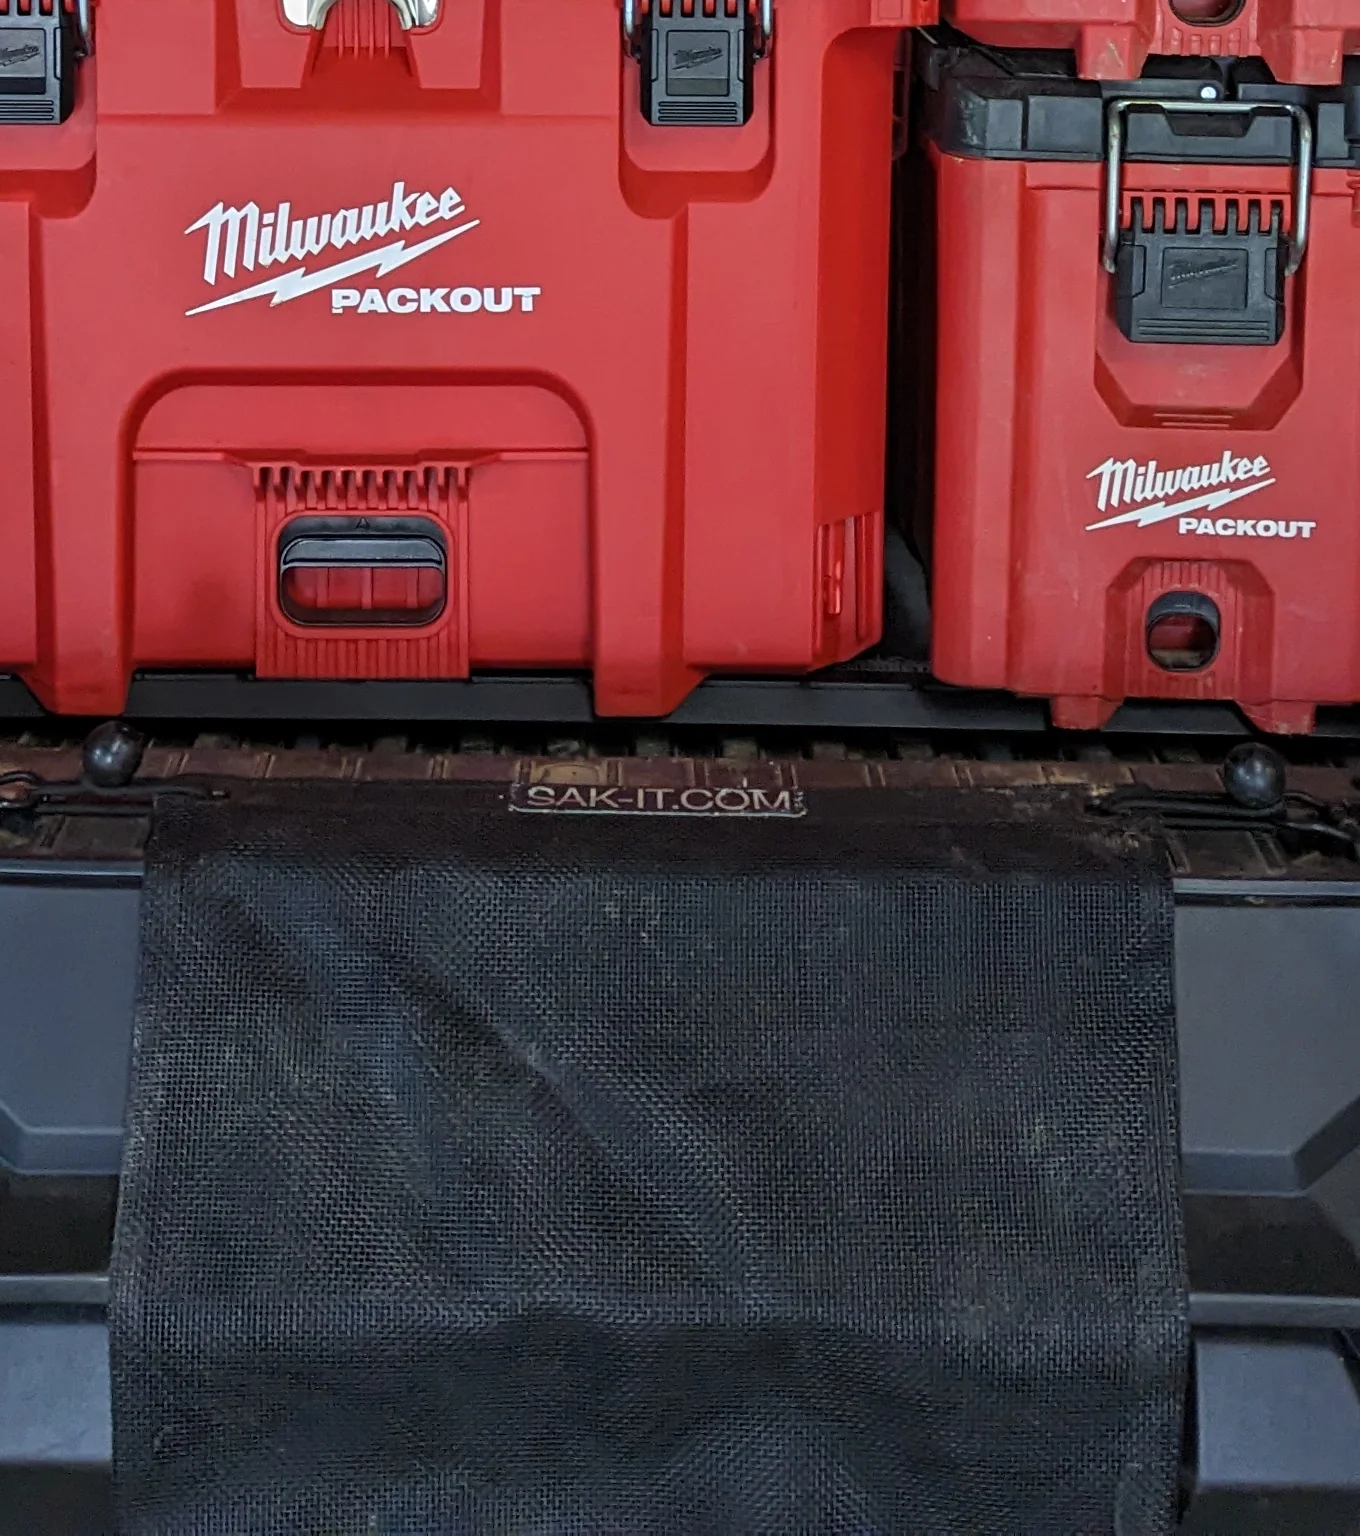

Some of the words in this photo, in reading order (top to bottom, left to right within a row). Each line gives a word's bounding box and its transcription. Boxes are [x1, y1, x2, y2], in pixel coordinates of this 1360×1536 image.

[184, 182, 465, 285] Milwaukee
[332, 287, 541, 313] PACKOUT
[1086, 450, 1271, 511] Milwaukee
[1179, 518, 1316, 538] PACKOUT
[527, 785, 790, 811] SAK-IT.COM
